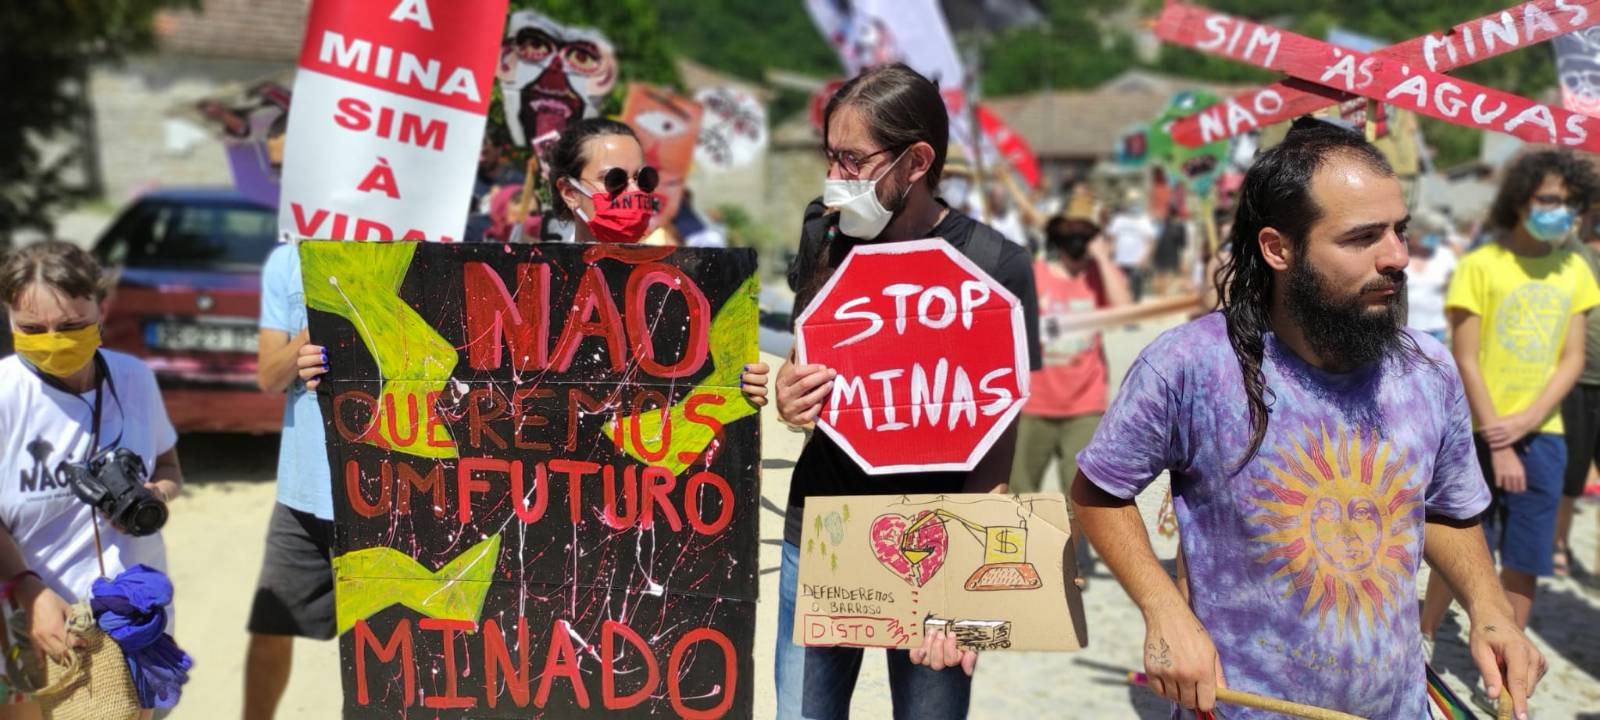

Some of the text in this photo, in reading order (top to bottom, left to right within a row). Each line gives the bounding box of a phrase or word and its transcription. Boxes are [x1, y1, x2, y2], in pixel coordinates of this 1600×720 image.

[319, 30, 482, 103] MINA
[1197, 15, 1281, 67] SIM
[1423, 0, 1588, 72] MINAS
[333, 97, 448, 151] SIM
[357, 156, 401, 199] À
[463, 244, 711, 378] NÃO
[832, 279, 991, 349] STOP
[333, 386, 728, 465] QUEREMOS
[829, 357, 1014, 431] MINAS
[346, 458, 735, 535] UM FUTURO
[801, 583, 895, 604] DEFENDEREMOS
[829, 602, 882, 615] BARROSO
[355, 616, 738, 720] MINADO
